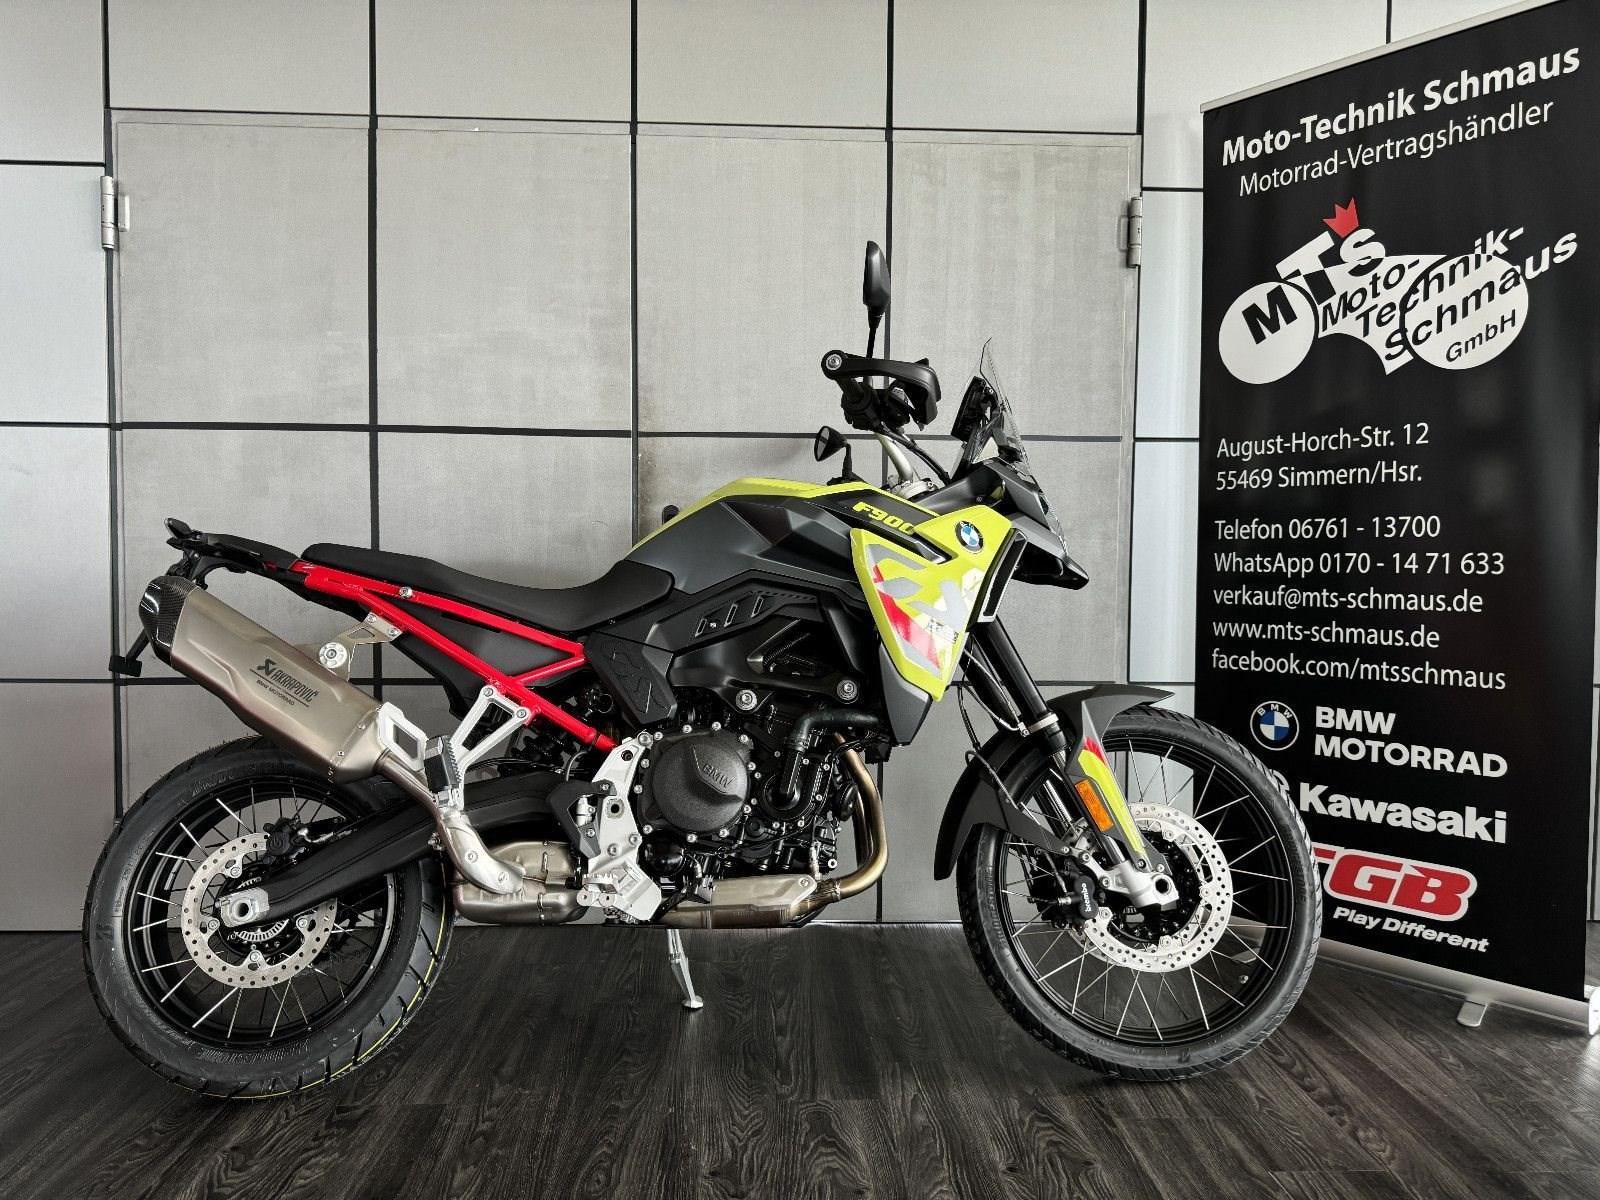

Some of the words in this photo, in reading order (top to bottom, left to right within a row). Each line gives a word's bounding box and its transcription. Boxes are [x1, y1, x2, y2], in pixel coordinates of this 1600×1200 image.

[1222, 88, 1415, 166] Moto-Technik
[1423, 47, 1580, 111] Schmaus
[1239, 99, 1554, 197] Motorrad-Vertragshändler
[1242, 229, 1386, 345] MTS
[1321, 258, 1420, 332] Moto-
[1445, 309, 1517, 362] GmbH
[1216, 425, 1395, 461] August-Horch-Str.
[1403, 422, 1429, 445] 12
[1216, 468, 1273, 490] 55469
[1278, 460, 1422, 488] Simmern/Hsr.
[1214, 517, 1283, 540] Telefon
[1288, 517, 1347, 539] 06761
[1372, 515, 1441, 538] 13700
[1214, 551, 1314, 578] WhatsApp
[1319, 552, 1371, 574] 0170
[1392, 552, 1419, 574] 14
[1425, 552, 1450, 575] 71
[1460, 552, 1505, 575] 633
[1213, 584, 1483, 613] verkauf@mts-schmaus.de
[1212, 620, 1440, 648] www.mts-schmaus.de
[1211, 648, 1506, 690] facebook.com/mtsschmaus
[1256, 703, 1293, 719] BMW
[1315, 705, 1396, 735] BMW
[1314, 734, 1508, 778] MOTORRAD
[1300, 782, 1507, 844] Kawasaki
[1081, 882, 1092, 912] brembo
[1312, 844, 1474, 919] GB
[1333, 906, 1381, 930] Play
[1382, 917, 1490, 953] Different
